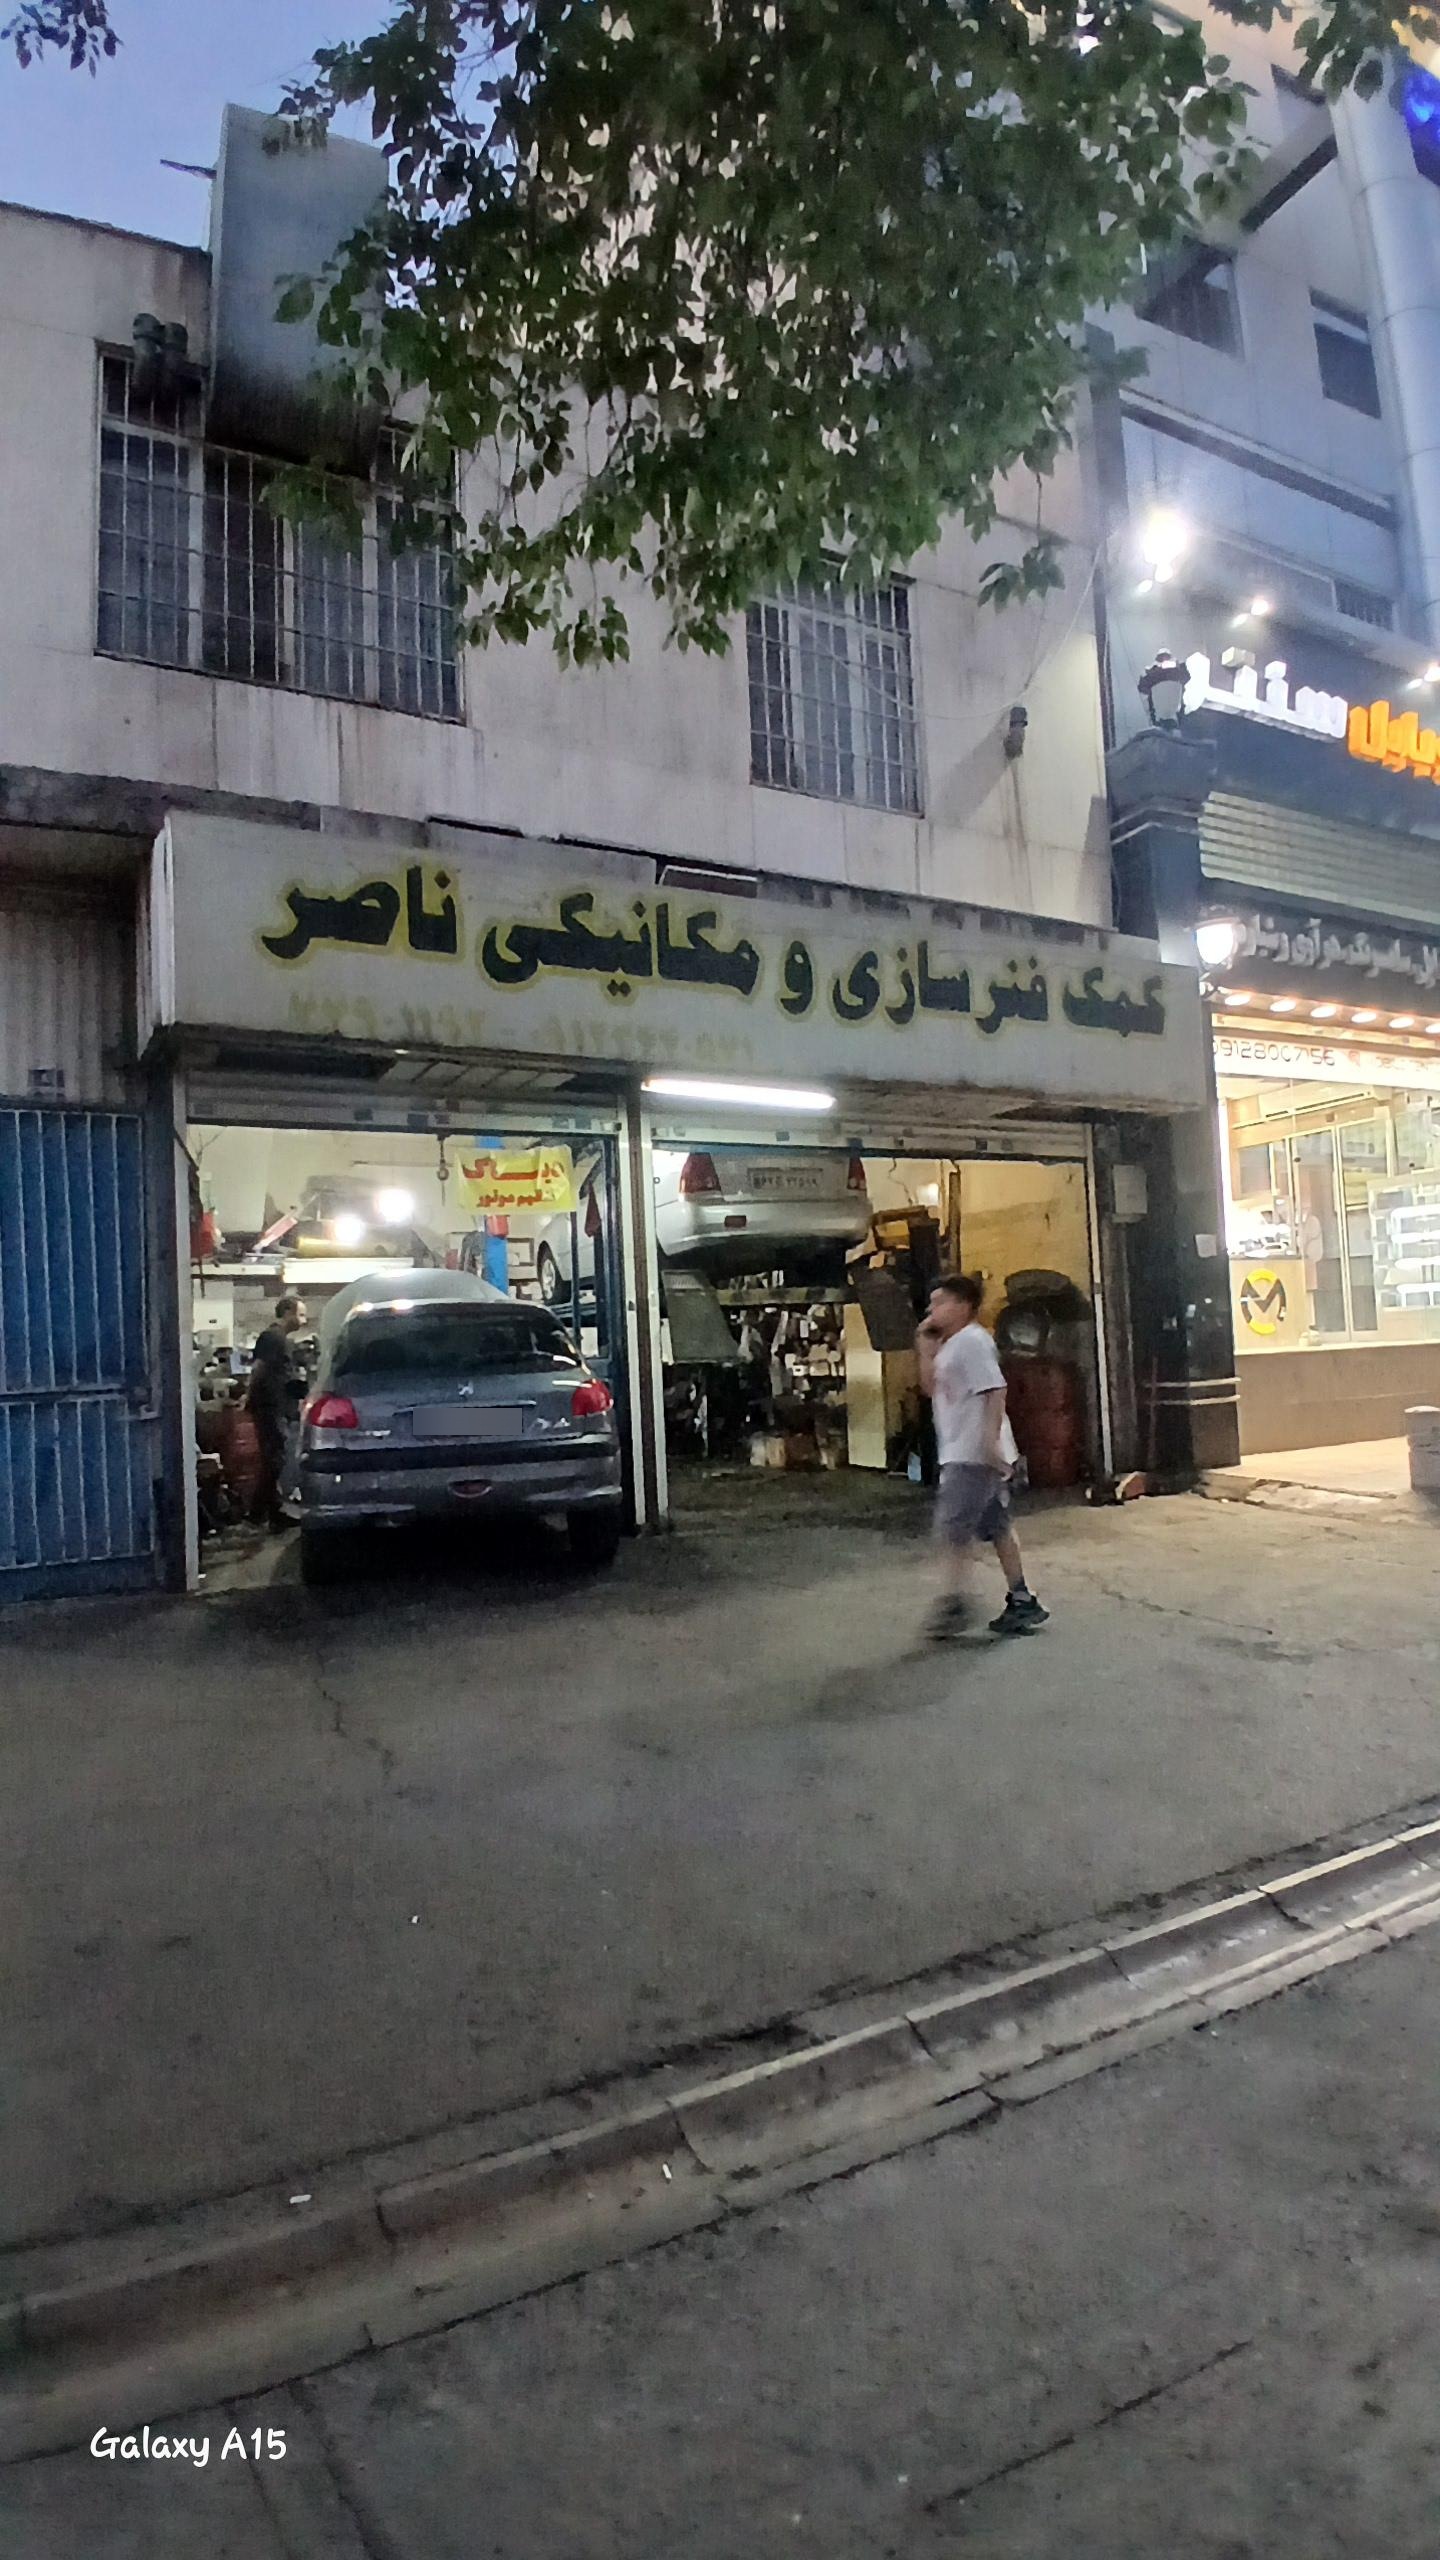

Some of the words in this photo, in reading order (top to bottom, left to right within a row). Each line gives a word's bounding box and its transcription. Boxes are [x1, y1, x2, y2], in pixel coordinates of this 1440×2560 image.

[1348, 699, 1440, 786] بایل
[262, 865, 457, 960] ناصر
[482, 892, 760, 998] مکانیکی
[779, 940, 814, 1015] و
[1063, 966, 1166, 1037] کمک
